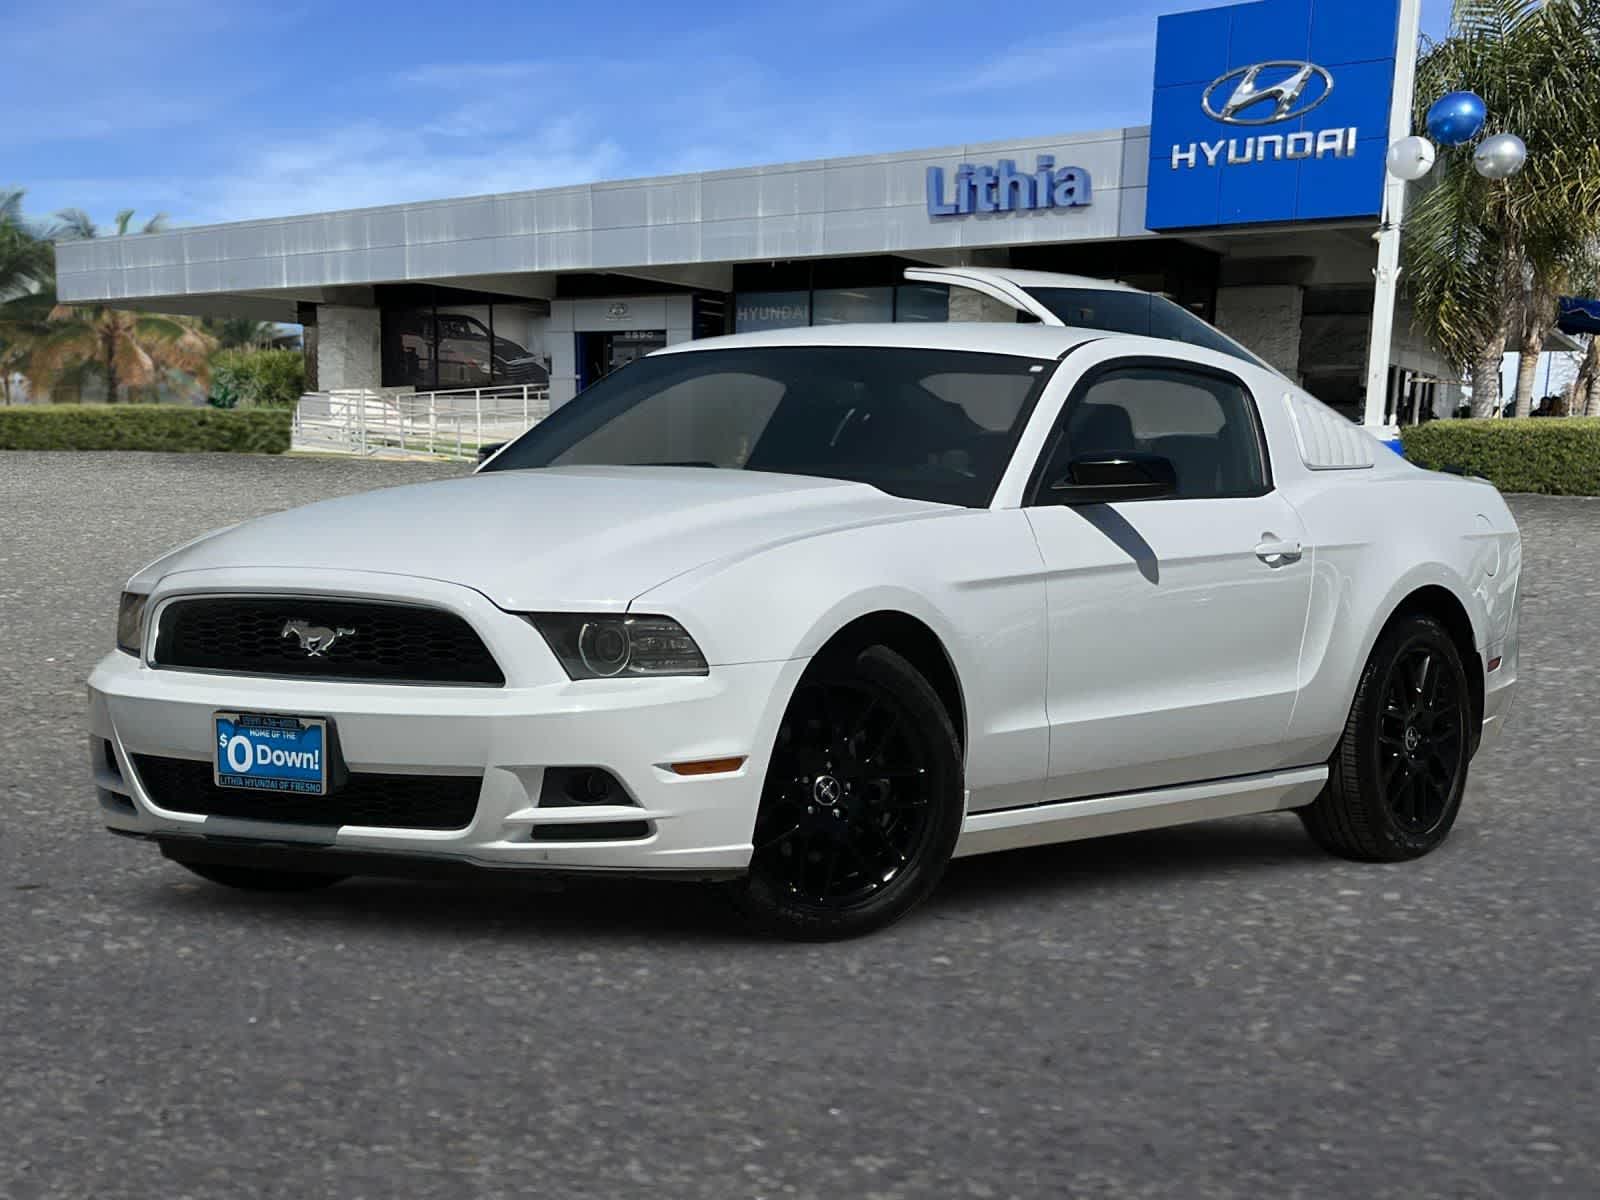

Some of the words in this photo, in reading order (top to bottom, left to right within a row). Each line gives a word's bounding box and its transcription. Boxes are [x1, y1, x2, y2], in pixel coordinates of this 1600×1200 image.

[1171, 127, 1357, 169] HYUNDAI
[926, 154, 1092, 218] Lithia
[736, 304, 809, 321] HYUNDAI
[249, 728, 269, 738] HOME
[271, 730, 281, 739] OF
[282, 731, 297, 740] THE
[256, 744, 319, 771] Down!
[220, 776, 244, 786] LITHIA
